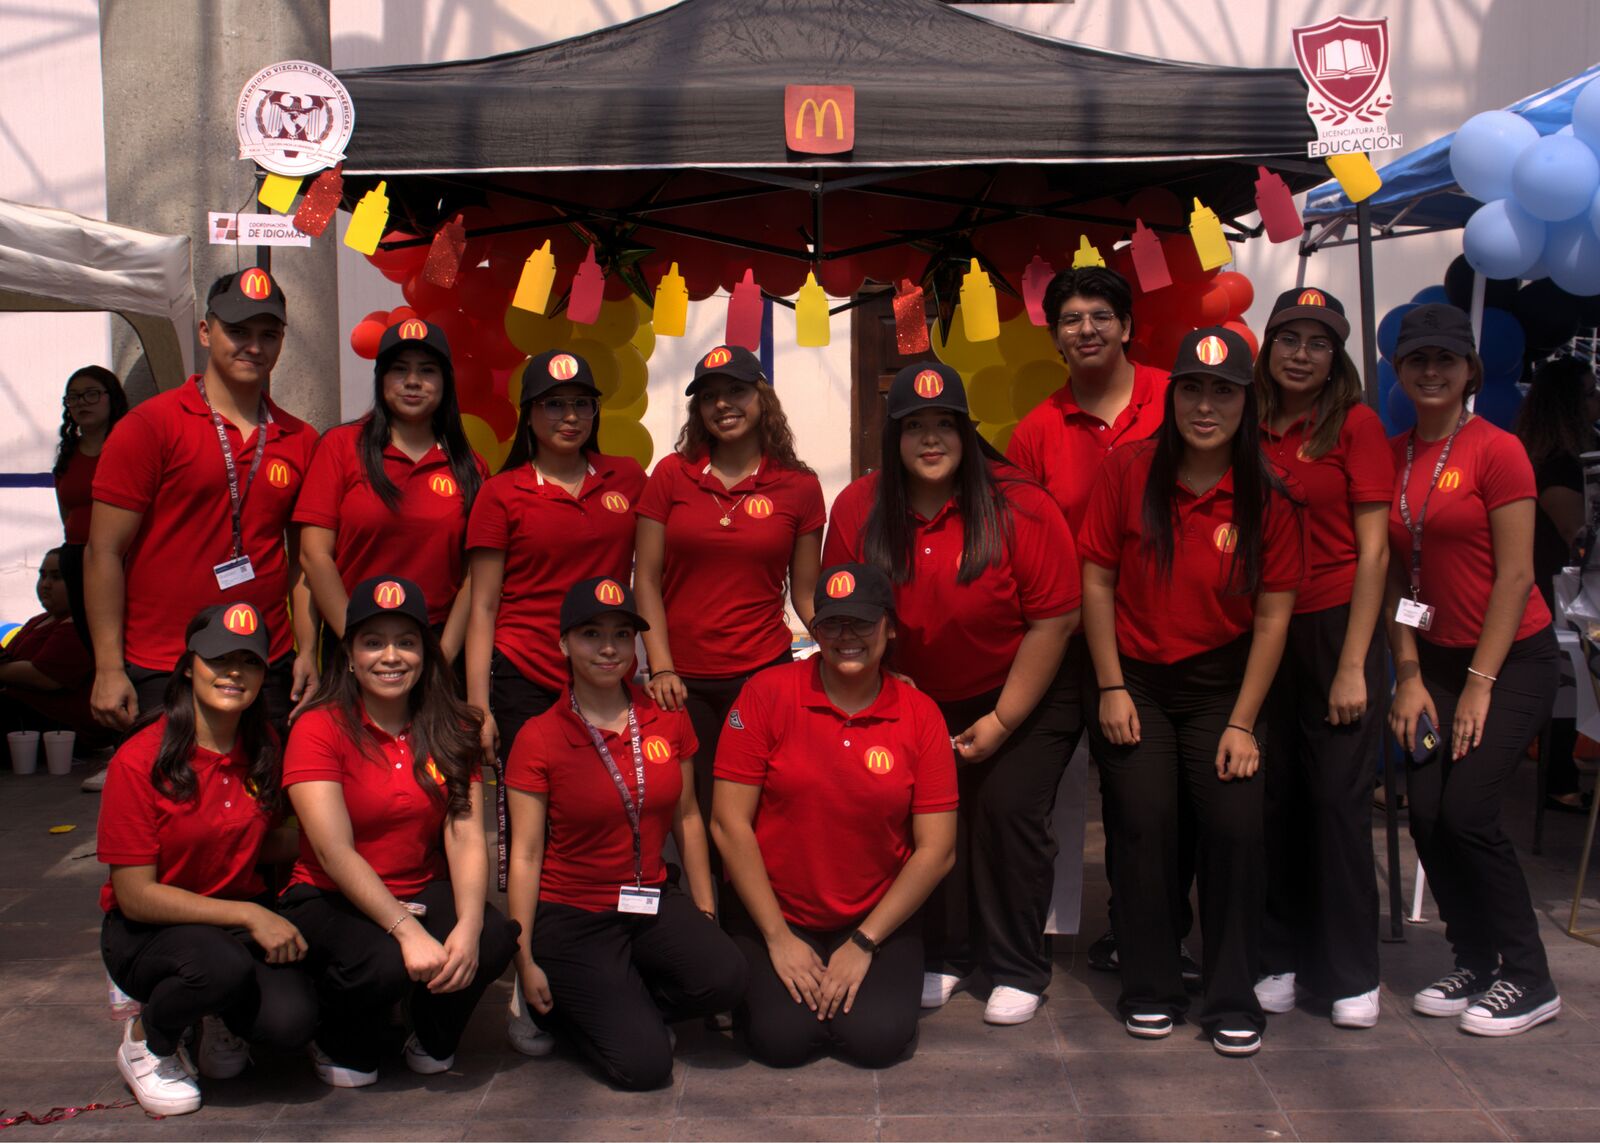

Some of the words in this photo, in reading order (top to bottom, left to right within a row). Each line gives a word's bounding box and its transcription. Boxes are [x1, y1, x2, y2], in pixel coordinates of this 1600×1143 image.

[240, 71, 272, 118] UNIVERSIDAD
[273, 64, 309, 73] VIZCAYA
[311, 68, 323, 76] DE
[323, 75, 338, 89] LAS
[795, 98, 844, 141] M
[1322, 127, 1375, 139] LICENCIATURA
[1310, 133, 1402, 156] EDUCACIÓN
[248, 229, 261, 238] DE
[244, 274, 269, 296] M
[403, 322, 425, 338] M
[706, 350, 728, 368] M
[917, 374, 940, 394] M
[217, 424, 228, 441] UVA
[225, 452, 234, 470] UVA
[269, 463, 287, 484] M
[1438, 471, 1460, 489] M
[432, 476, 453, 495] M
[606, 495, 627, 511] M
[748, 498, 770, 515] M
[599, 583, 621, 602] M
[829, 575, 852, 595] M
[376, 586, 401, 606] M
[228, 608, 255, 631] M
[631, 736, 641, 754] UVA
[647, 740, 669, 761] M
[867, 751, 890, 770] M
[636, 766, 645, 784] UVA
[499, 844, 507, 862] UVA
